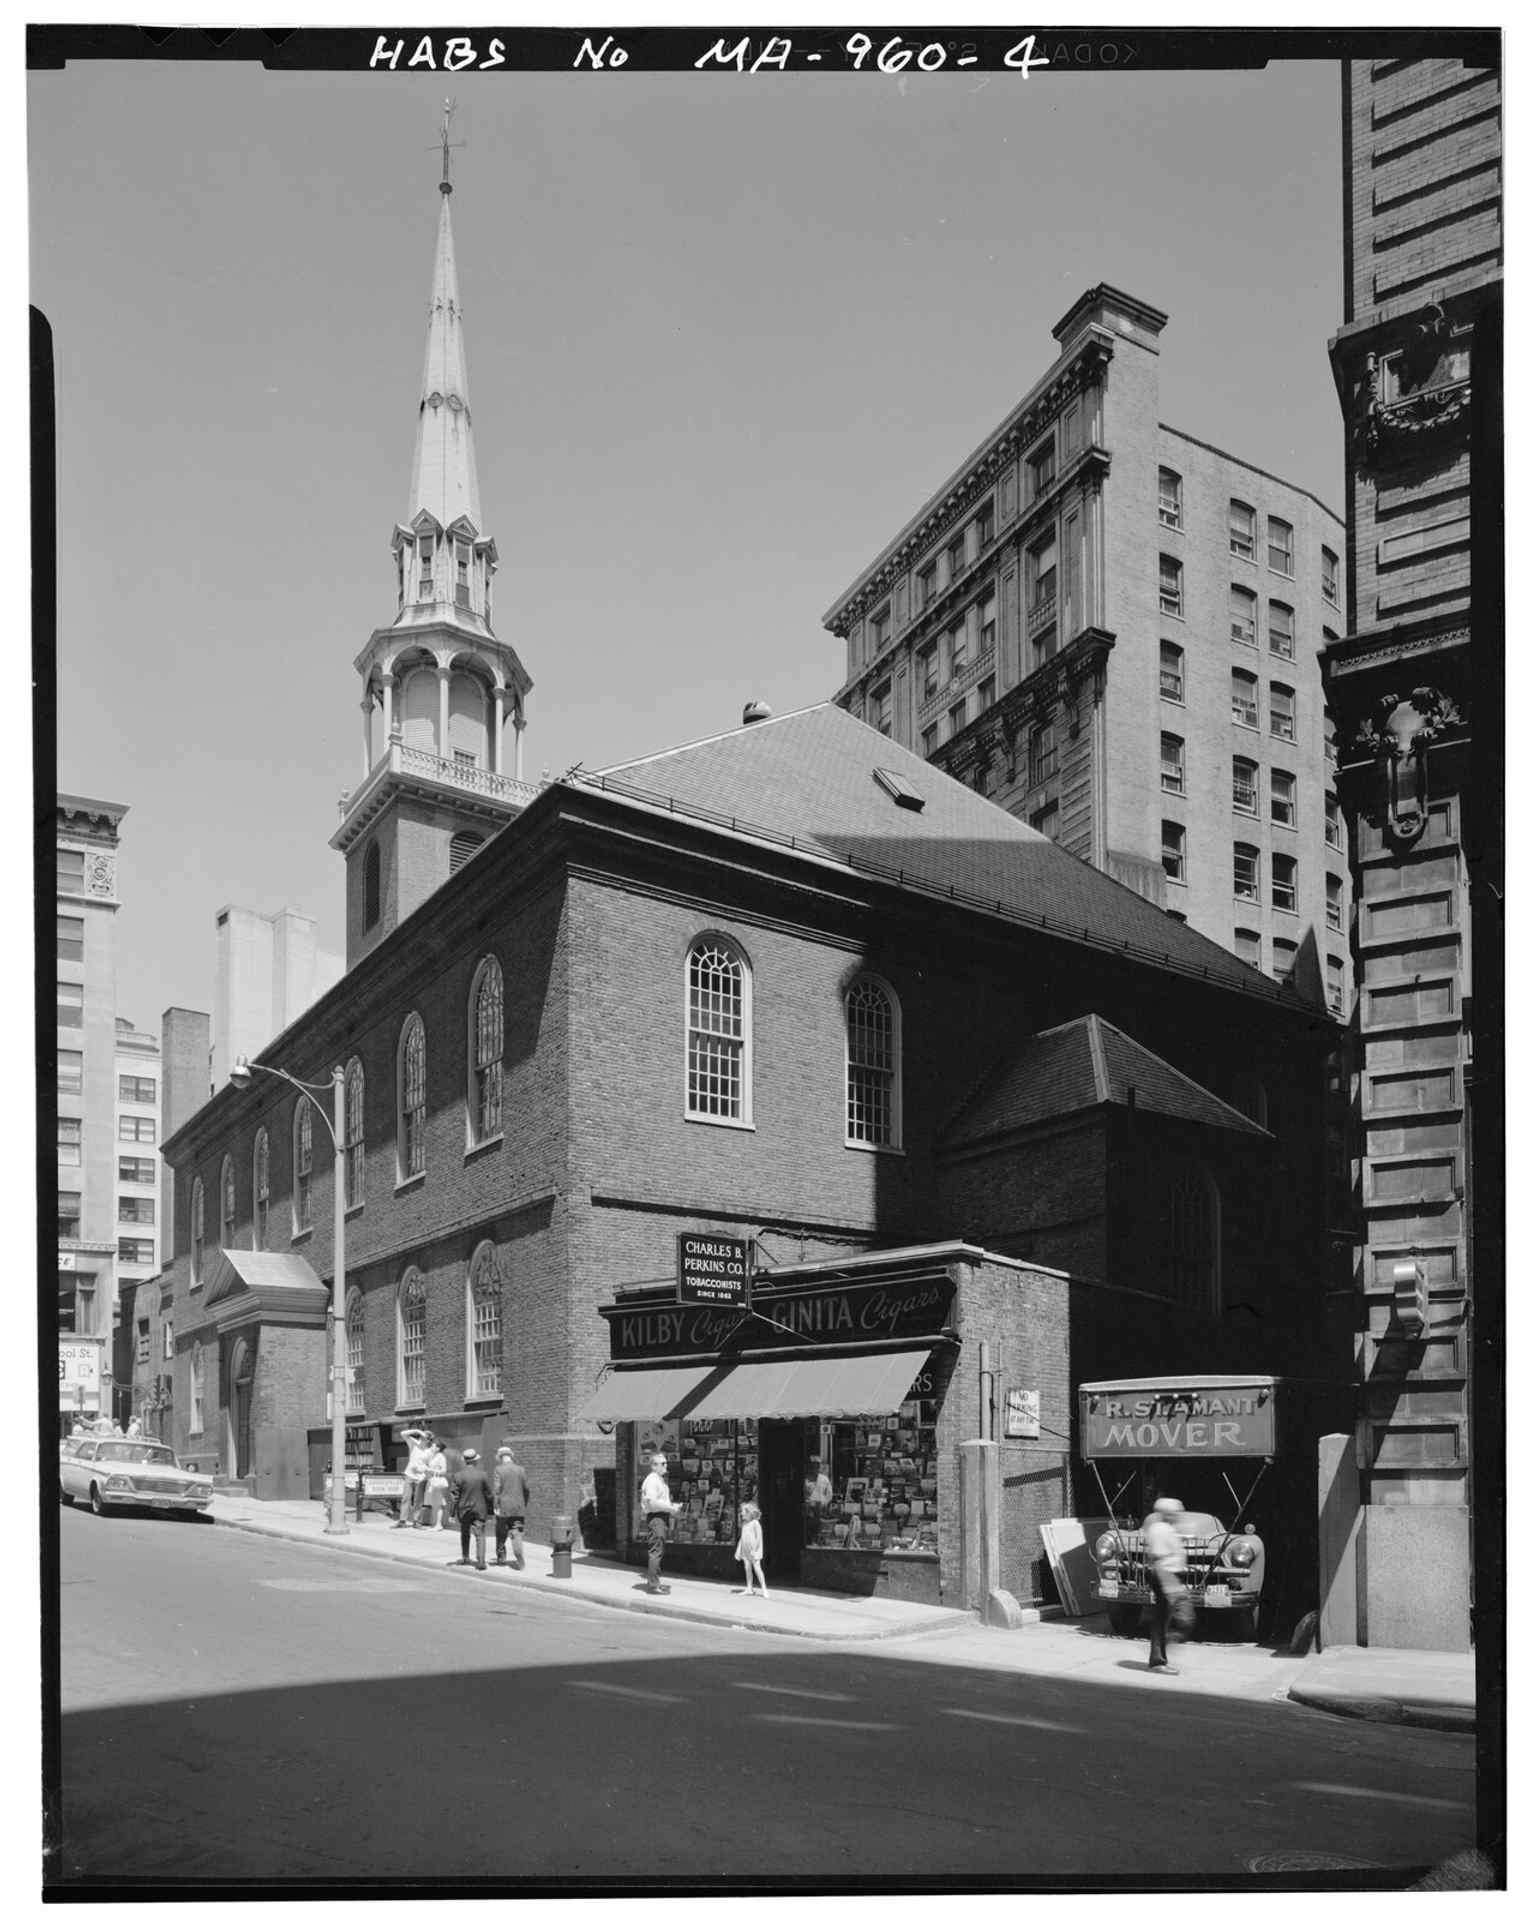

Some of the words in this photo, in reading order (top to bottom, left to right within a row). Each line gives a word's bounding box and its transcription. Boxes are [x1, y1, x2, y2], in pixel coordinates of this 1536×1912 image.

[686, 1240, 732, 1258] CHARLES
[735, 1247, 744, 1259] B.
[684, 1257, 725, 1273] PERKINS
[727, 1262, 744, 1275] CO.
[685, 1276, 742, 1290] TOBACCONISTS
[697, 1290, 716, 1299] SINCE
[861, 1287, 942, 1332] Cigars
[622, 1312, 686, 1347] KILBY
[911, 1373, 933, 1393] RS
[1106, 1400, 1131, 1418] R.
[1104, 1422, 1247, 1448] MOVER
